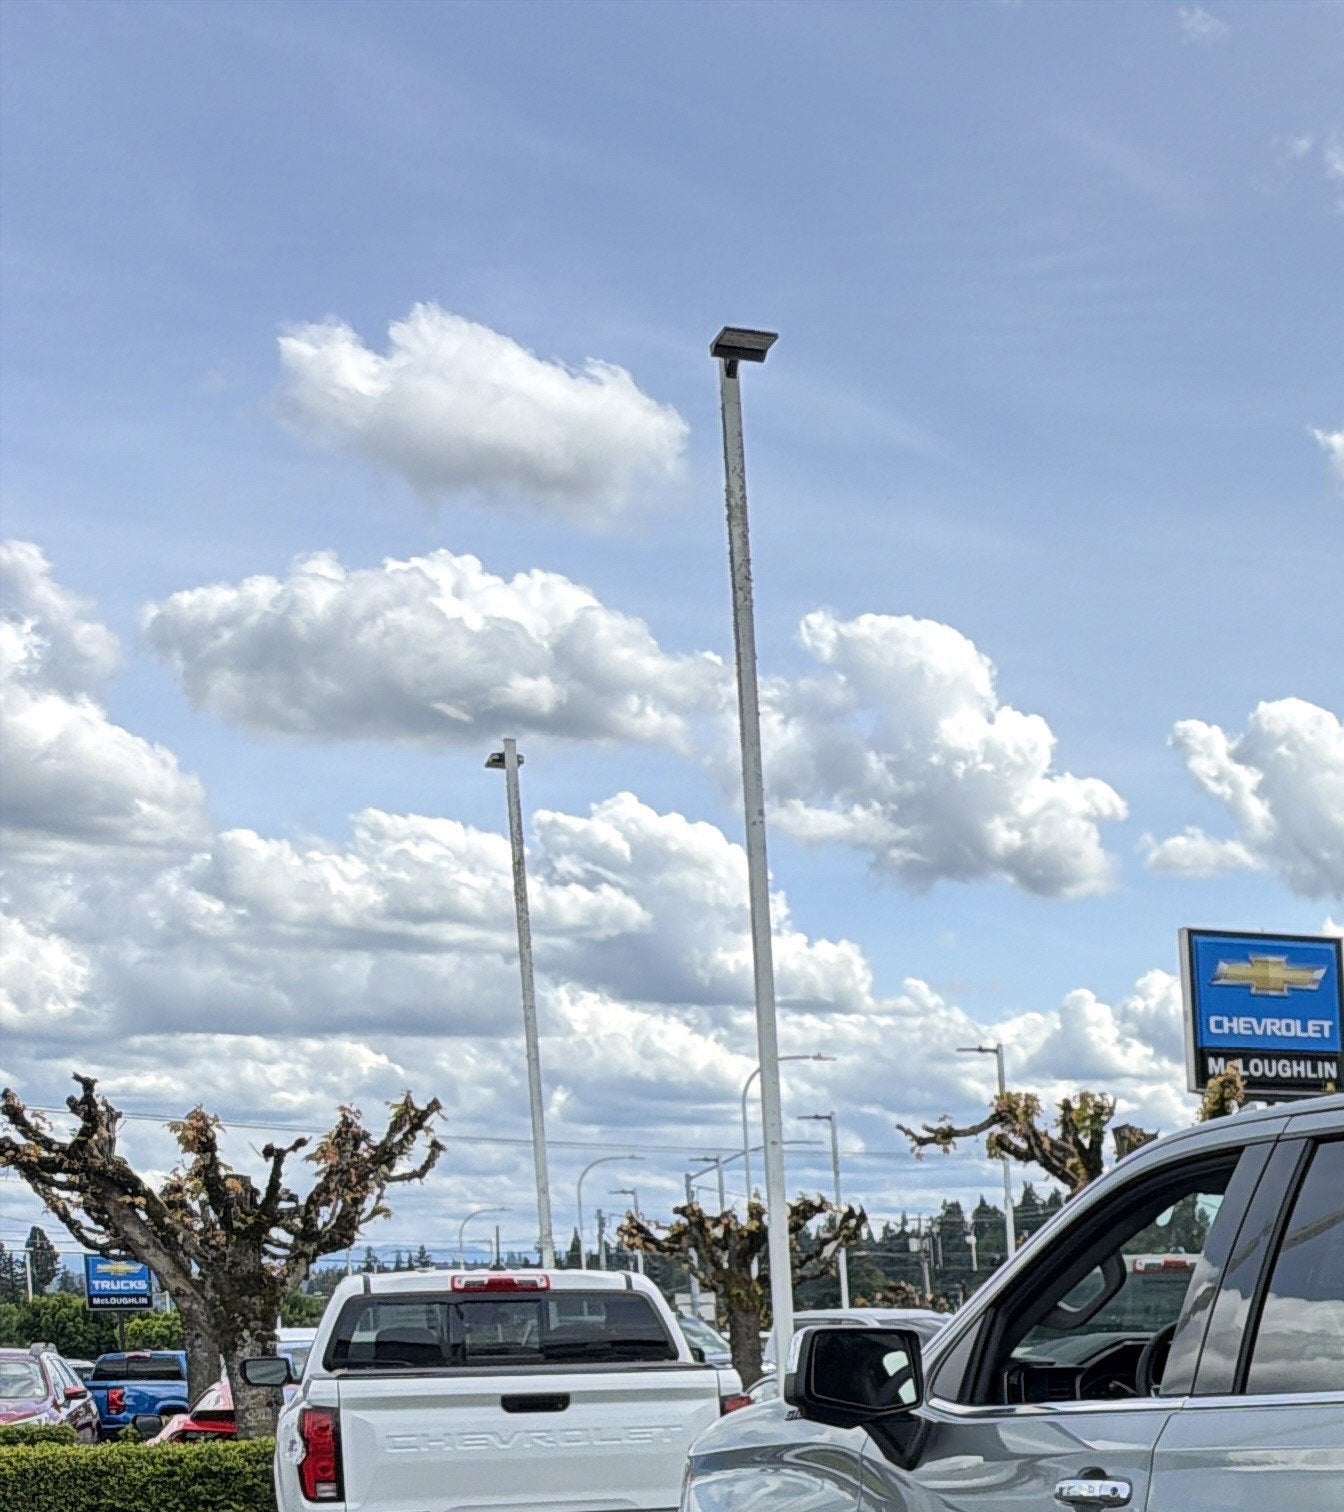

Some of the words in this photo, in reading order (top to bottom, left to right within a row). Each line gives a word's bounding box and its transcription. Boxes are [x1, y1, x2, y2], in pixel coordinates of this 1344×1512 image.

[1209, 1015, 1333, 1038] CHEVROLET
[92, 1280, 148, 1290] TRUCKS
[386, 1424, 683, 1452] CHEVROLET
